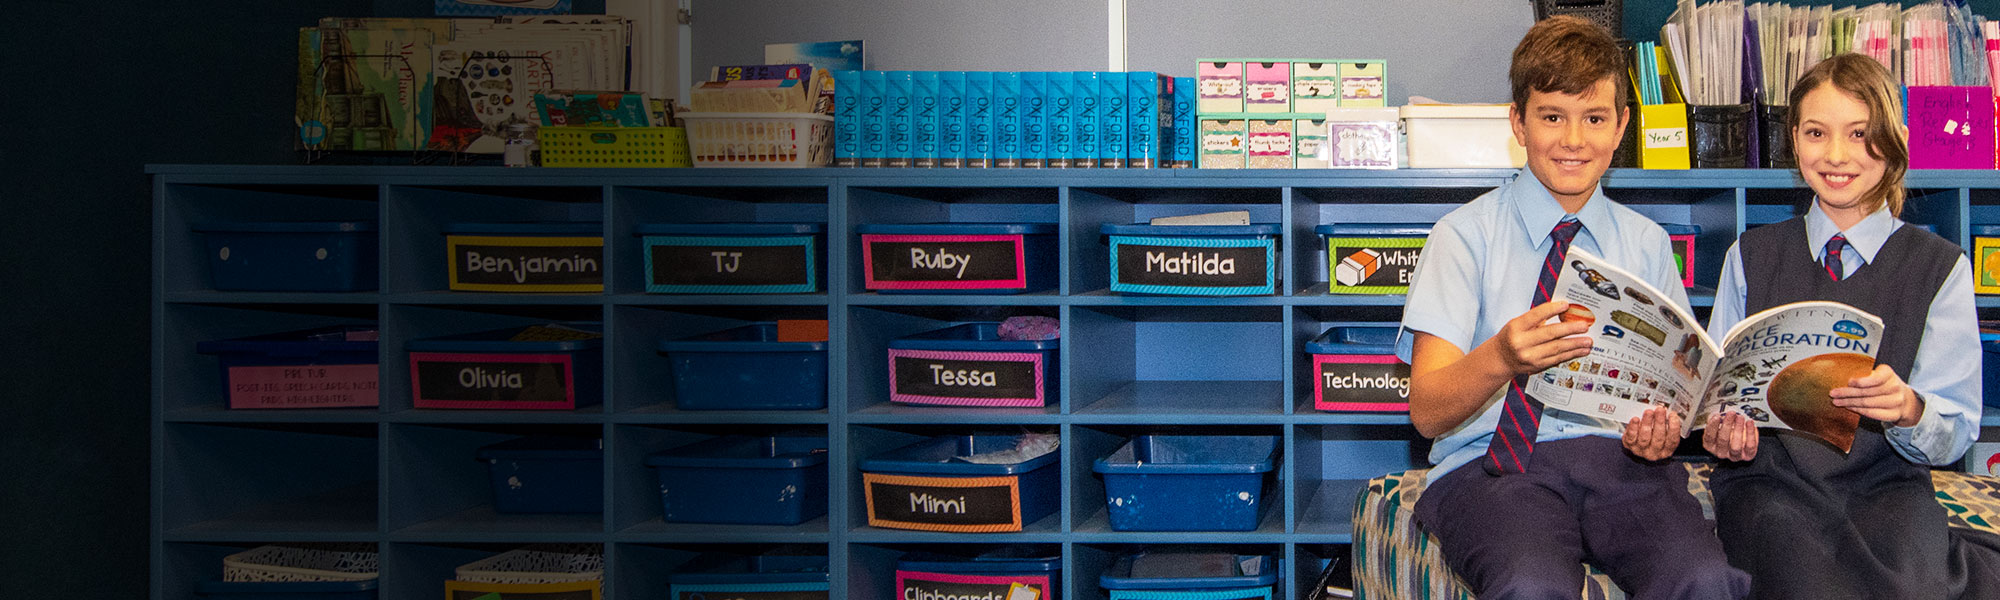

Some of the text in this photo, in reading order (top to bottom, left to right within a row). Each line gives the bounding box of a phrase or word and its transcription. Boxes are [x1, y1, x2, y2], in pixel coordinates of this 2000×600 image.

[844, 96, 856, 153] OXFORD
[870, 96, 882, 153] OXFORD
[896, 96, 908, 153] OXFORD
[923, 96, 935, 153] OXFORD
[950, 96, 962, 153] OXFORD
[977, 96, 989, 153] OXFORD
[1004, 96, 1016, 153] OXFORD
[1030, 97, 1042, 154] OXFORD
[1057, 97, 1069, 154] OXFORD
[1083, 97, 1095, 154] OXFORD
[1110, 97, 1122, 154] OXFORD
[1138, 97, 1150, 154] OXFORD
[1178, 101, 1190, 156] OXFORD
[1649, 130, 1683, 143] Year 5
[466, 251, 597, 285] Benjamin
[711, 251, 743, 274] TJ
[910, 247, 971, 280] Ruby
[1145, 251, 1235, 275] Matilda
[1836, 324, 1865, 336] $2.99
[459, 367, 523, 389] Olivia
[929, 364, 997, 387] Tessa
[1323, 372, 1411, 398] Technolog
[910, 491, 966, 515] Mimi
